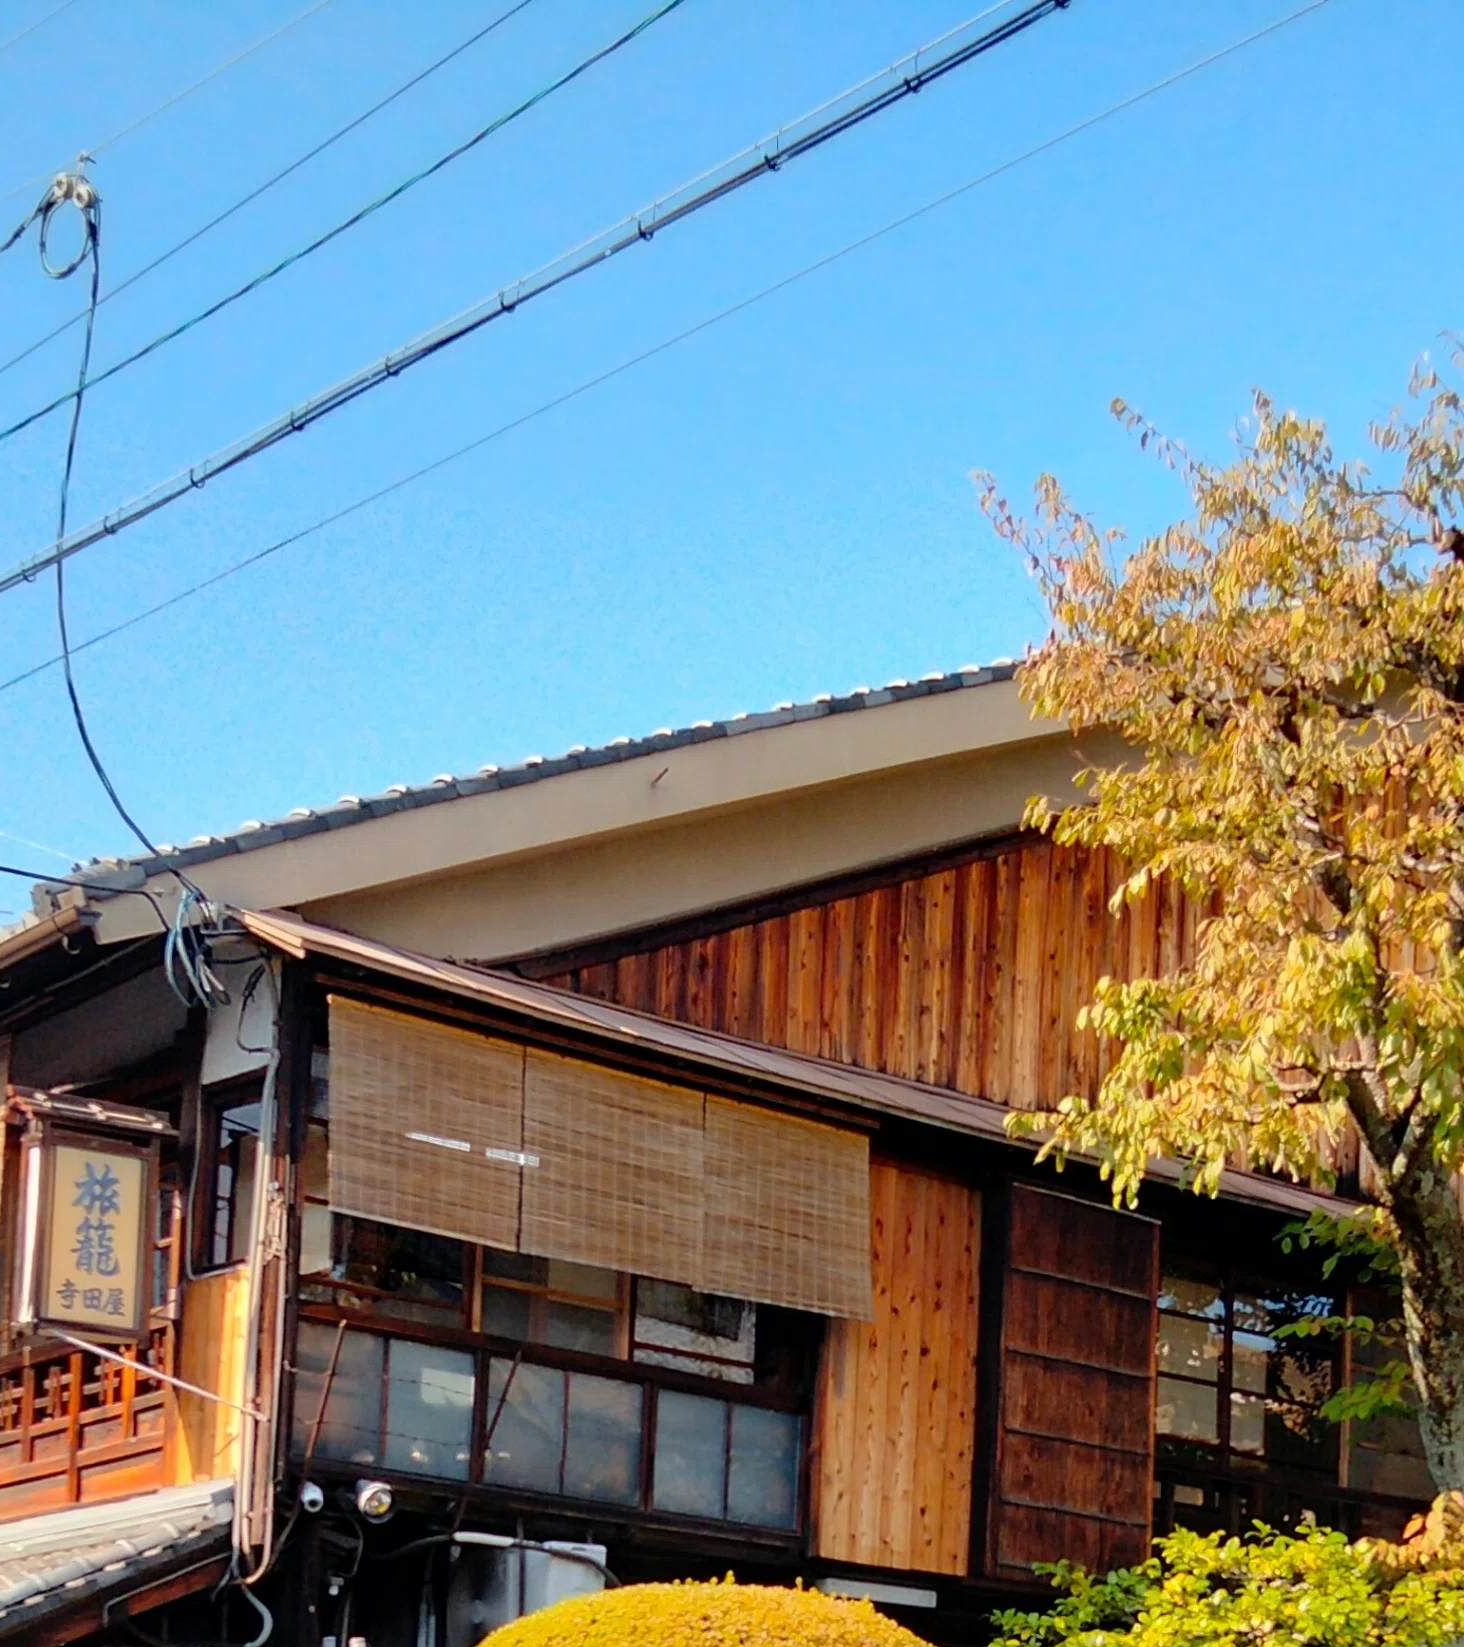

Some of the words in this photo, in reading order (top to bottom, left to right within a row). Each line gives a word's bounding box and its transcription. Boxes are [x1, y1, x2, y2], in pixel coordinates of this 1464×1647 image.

[72, 1161, 122, 1278] 旅籠
[55, 1278, 127, 1318] 寺田屋
